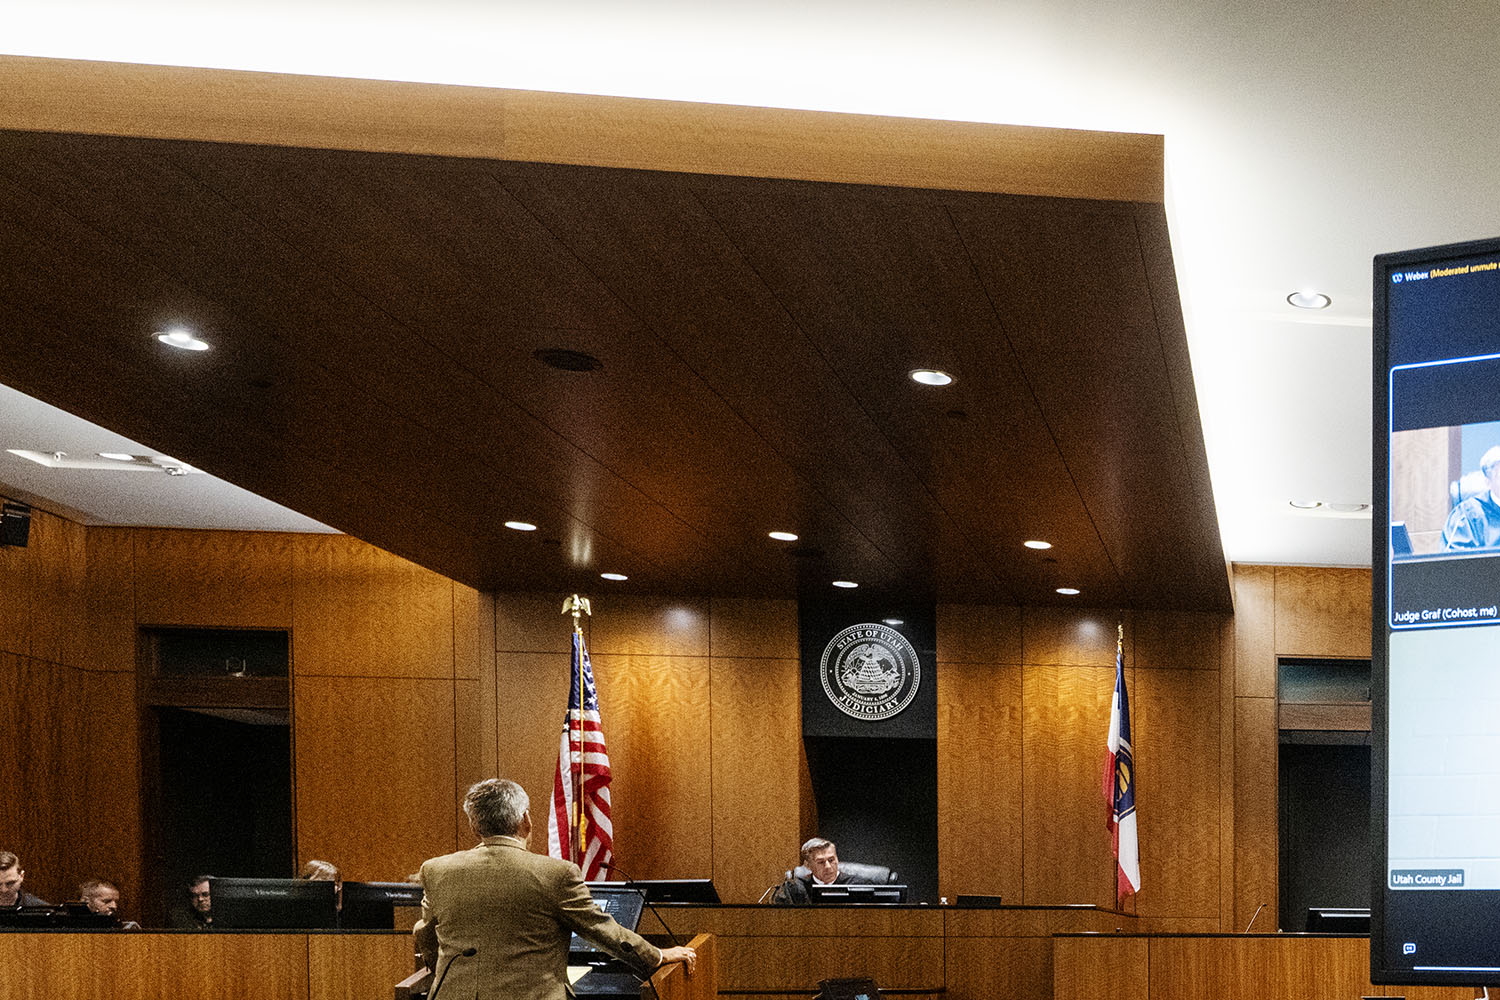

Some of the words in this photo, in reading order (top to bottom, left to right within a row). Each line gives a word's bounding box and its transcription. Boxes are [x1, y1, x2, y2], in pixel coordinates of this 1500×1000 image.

[1405, 271, 1429, 282] Webex
[1430, 265, 1470, 279] (Moderated
[1470, 262, 1498, 273] unmute
[1394, 611, 1420, 623] Judge
[1421, 608, 1442, 620] Graf
[1480, 605, 1498, 618] me)
[837, 630, 864, 650] STATE
[865, 630, 879, 638] OF
[880, 633, 904, 651] UTAH
[839, 695, 900, 714] JUDICIARY
[1392, 874, 1414, 884] Utah
[1414, 874, 1447, 886] County
[1447, 873, 1463, 884] Jail
